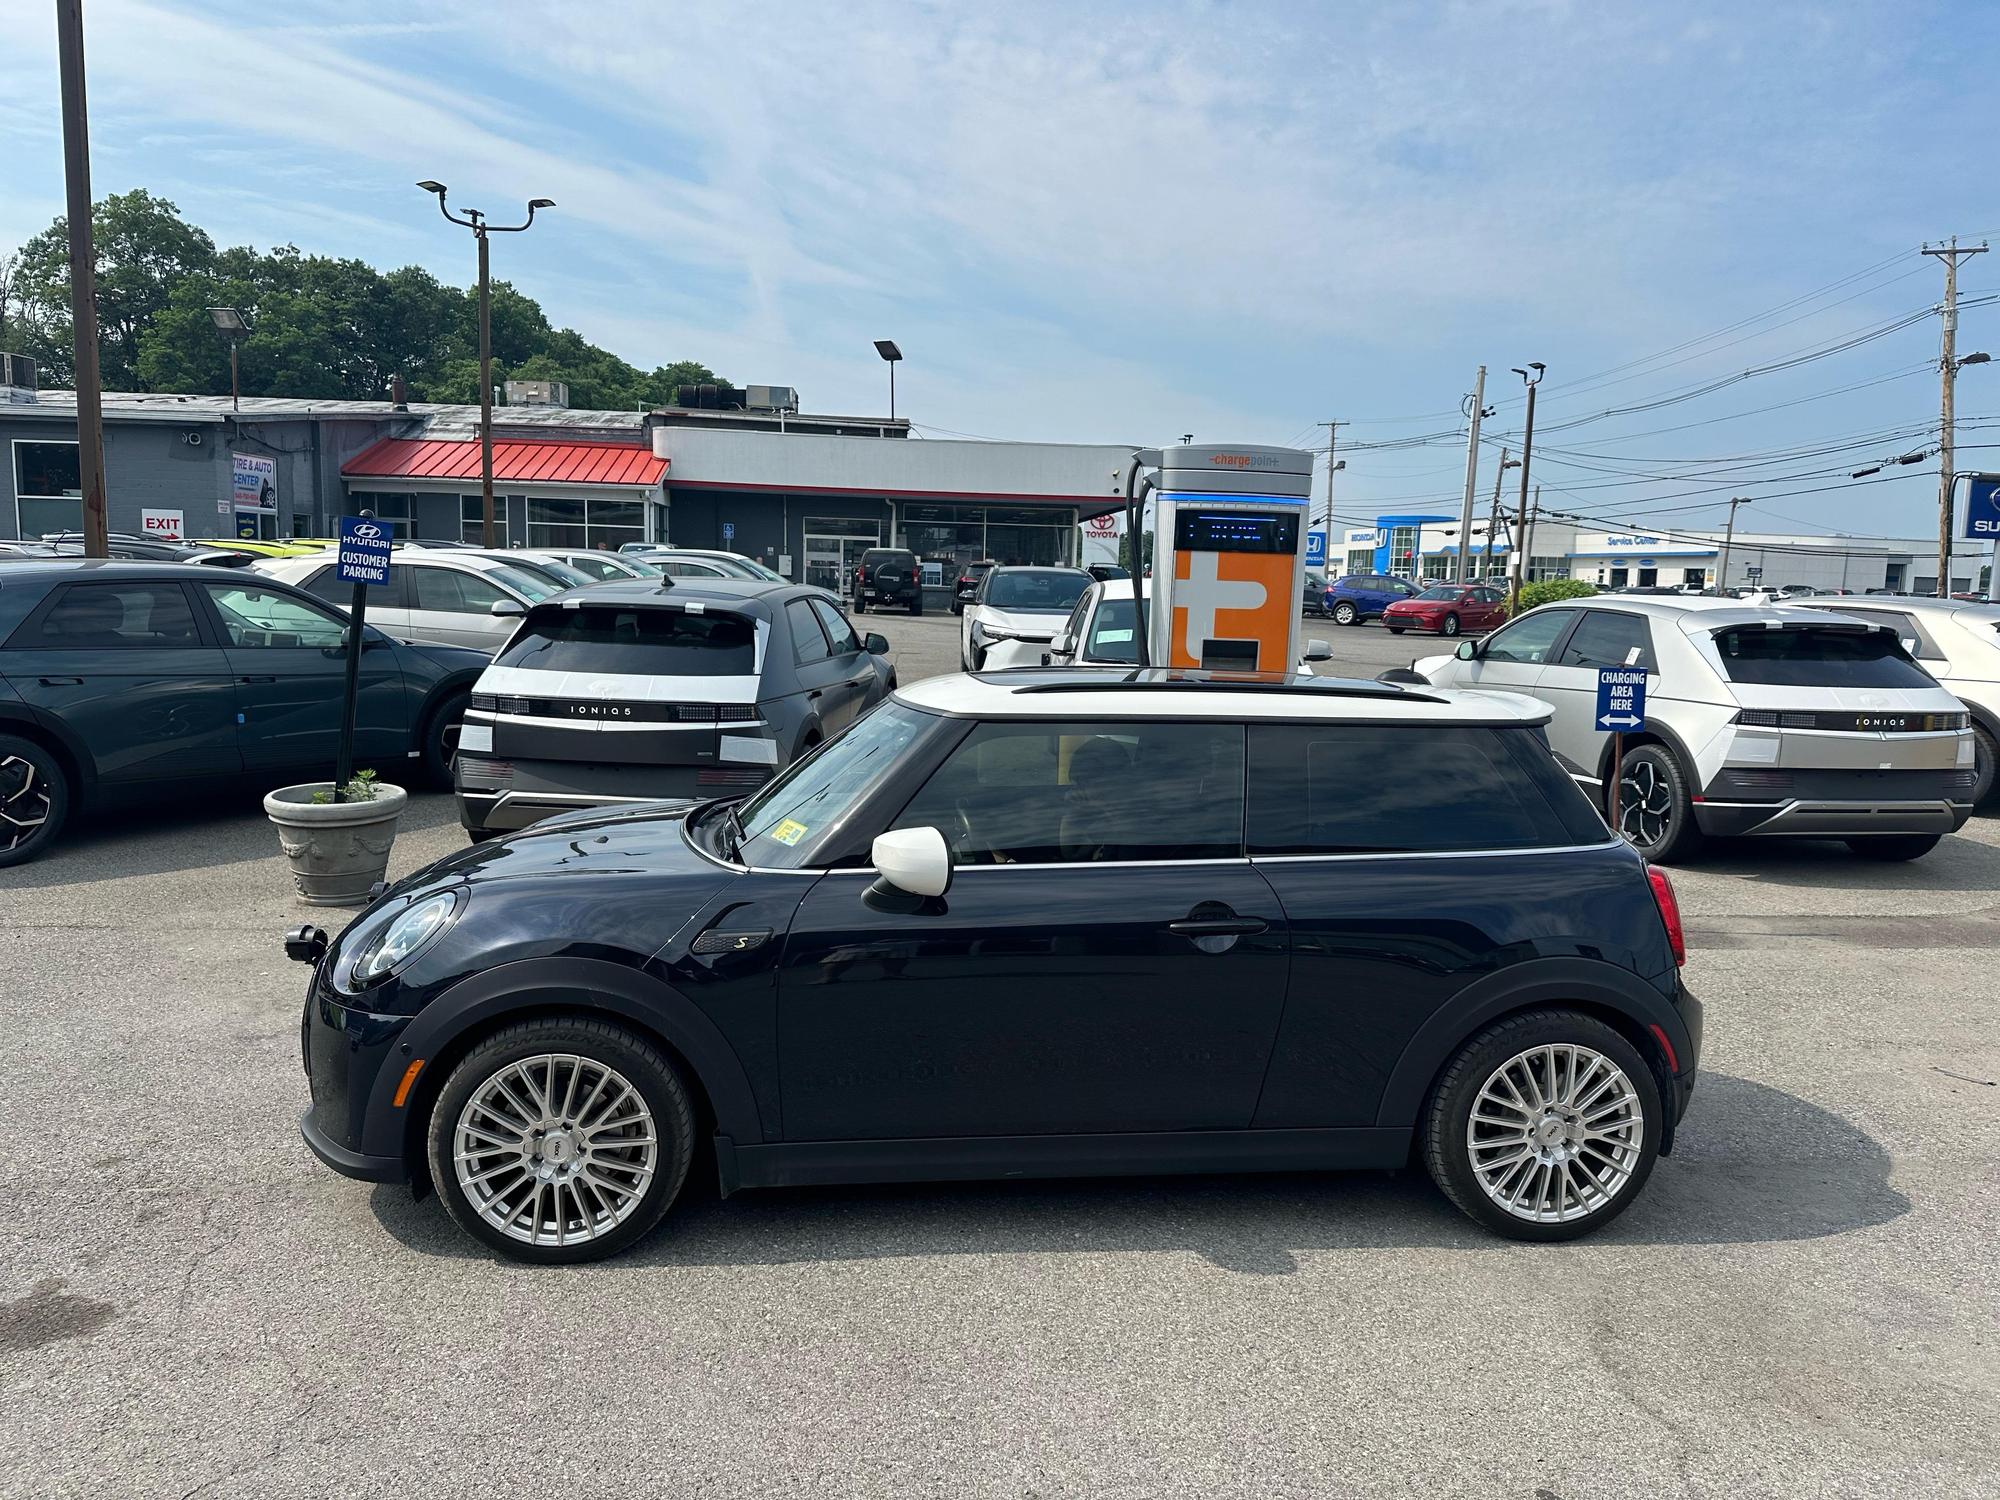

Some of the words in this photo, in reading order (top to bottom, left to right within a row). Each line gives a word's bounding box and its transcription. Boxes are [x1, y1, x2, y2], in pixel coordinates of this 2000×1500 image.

[248, 460, 254, 471] &
[254, 461, 272, 474] AUTO
[233, 472, 259, 486] CENTER
[146, 517, 180, 530] EXIT
[1085, 530, 1119, 539] TOYOTA
[1608, 536, 1633, 546] Service
[342, 535, 390, 549] HYUNDAI
[341, 551, 388, 568] CUSTOMER
[343, 564, 384, 581] PARKING
[1601, 671, 1645, 685] CHARGING
[1610, 685, 1634, 698] AREA
[1610, 698, 1633, 711] HERE
[734, 937, 749, 949] S
